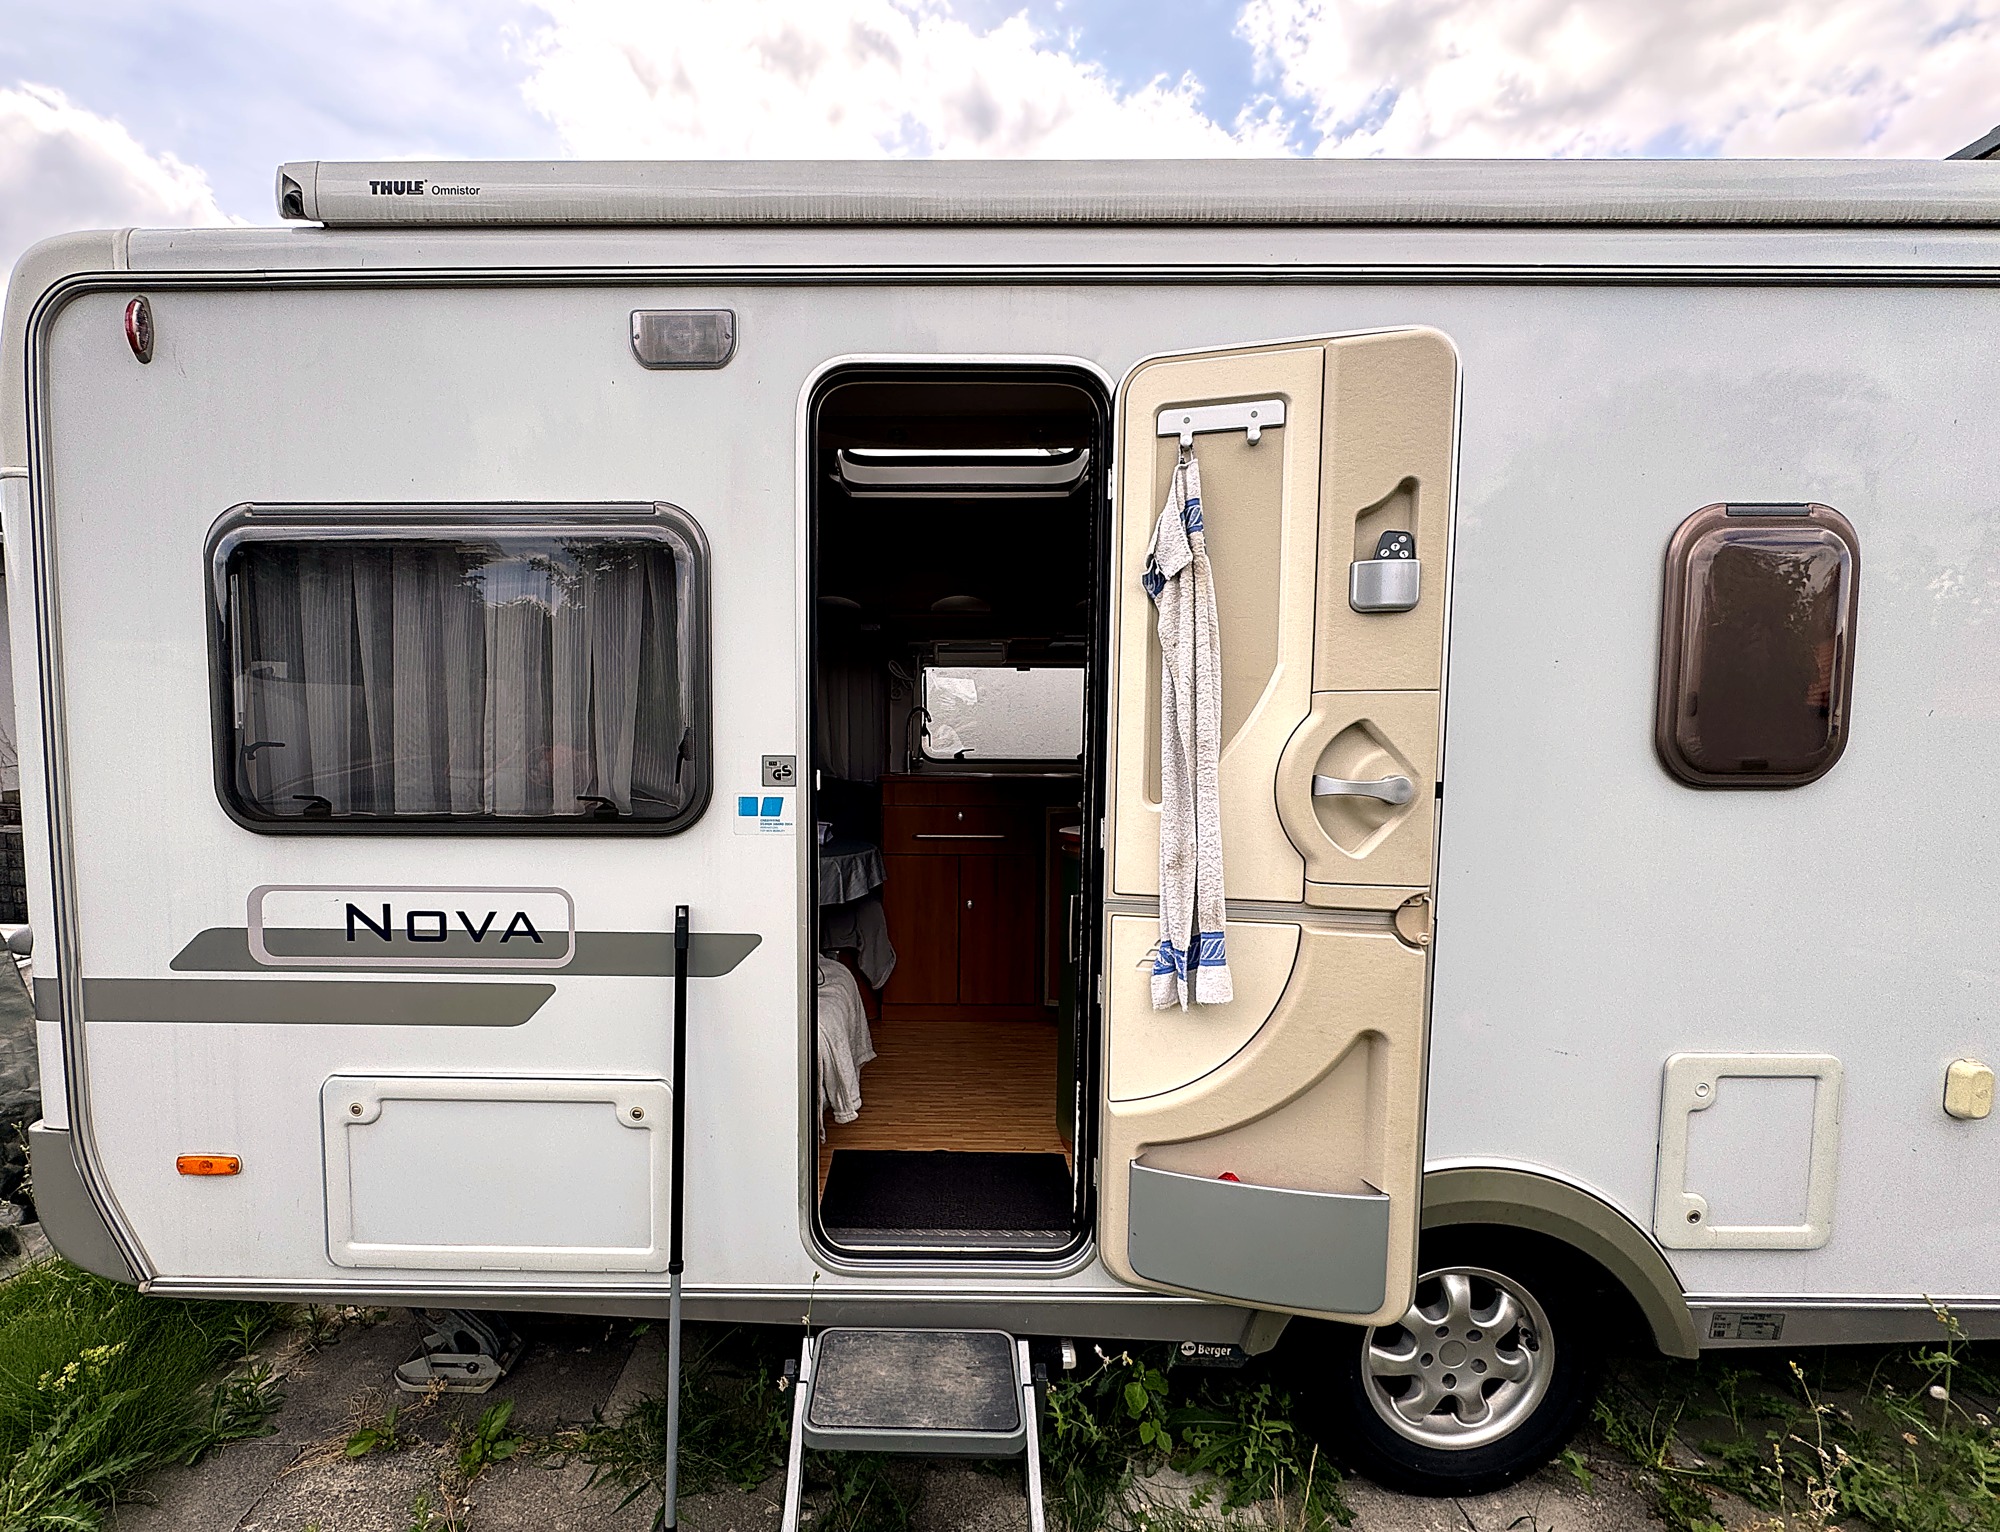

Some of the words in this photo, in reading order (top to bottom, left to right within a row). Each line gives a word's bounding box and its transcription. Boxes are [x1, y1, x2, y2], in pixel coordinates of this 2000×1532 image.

[369, 180, 424, 195] THULE
[431, 185, 480, 195] Omnistor
[772, 764, 792, 780] GS
[1197, 1344, 1232, 1358] Berger
